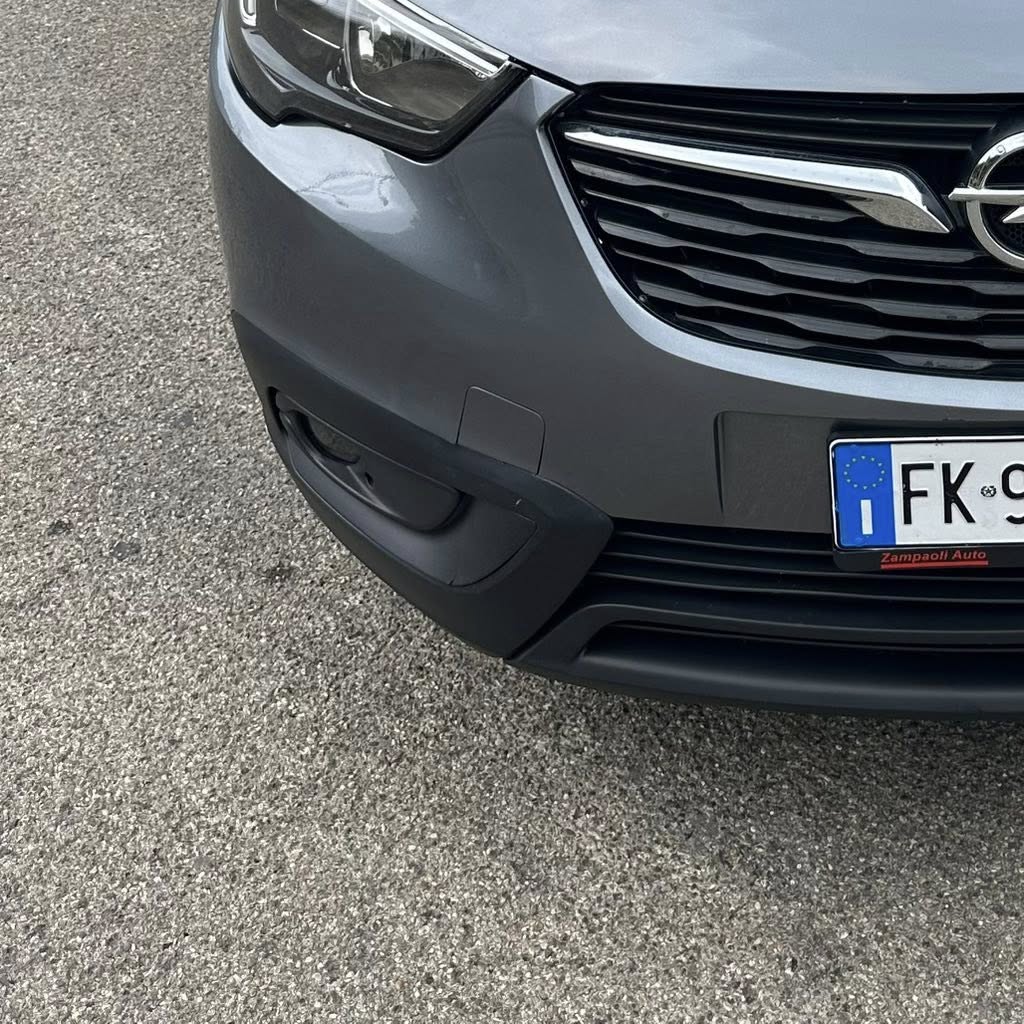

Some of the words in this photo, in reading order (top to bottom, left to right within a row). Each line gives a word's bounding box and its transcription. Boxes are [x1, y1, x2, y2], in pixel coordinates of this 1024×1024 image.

[901, 462, 976, 525] FK
[881, 550, 949, 565] Zampaoli
[951, 550, 987, 560] Auto
